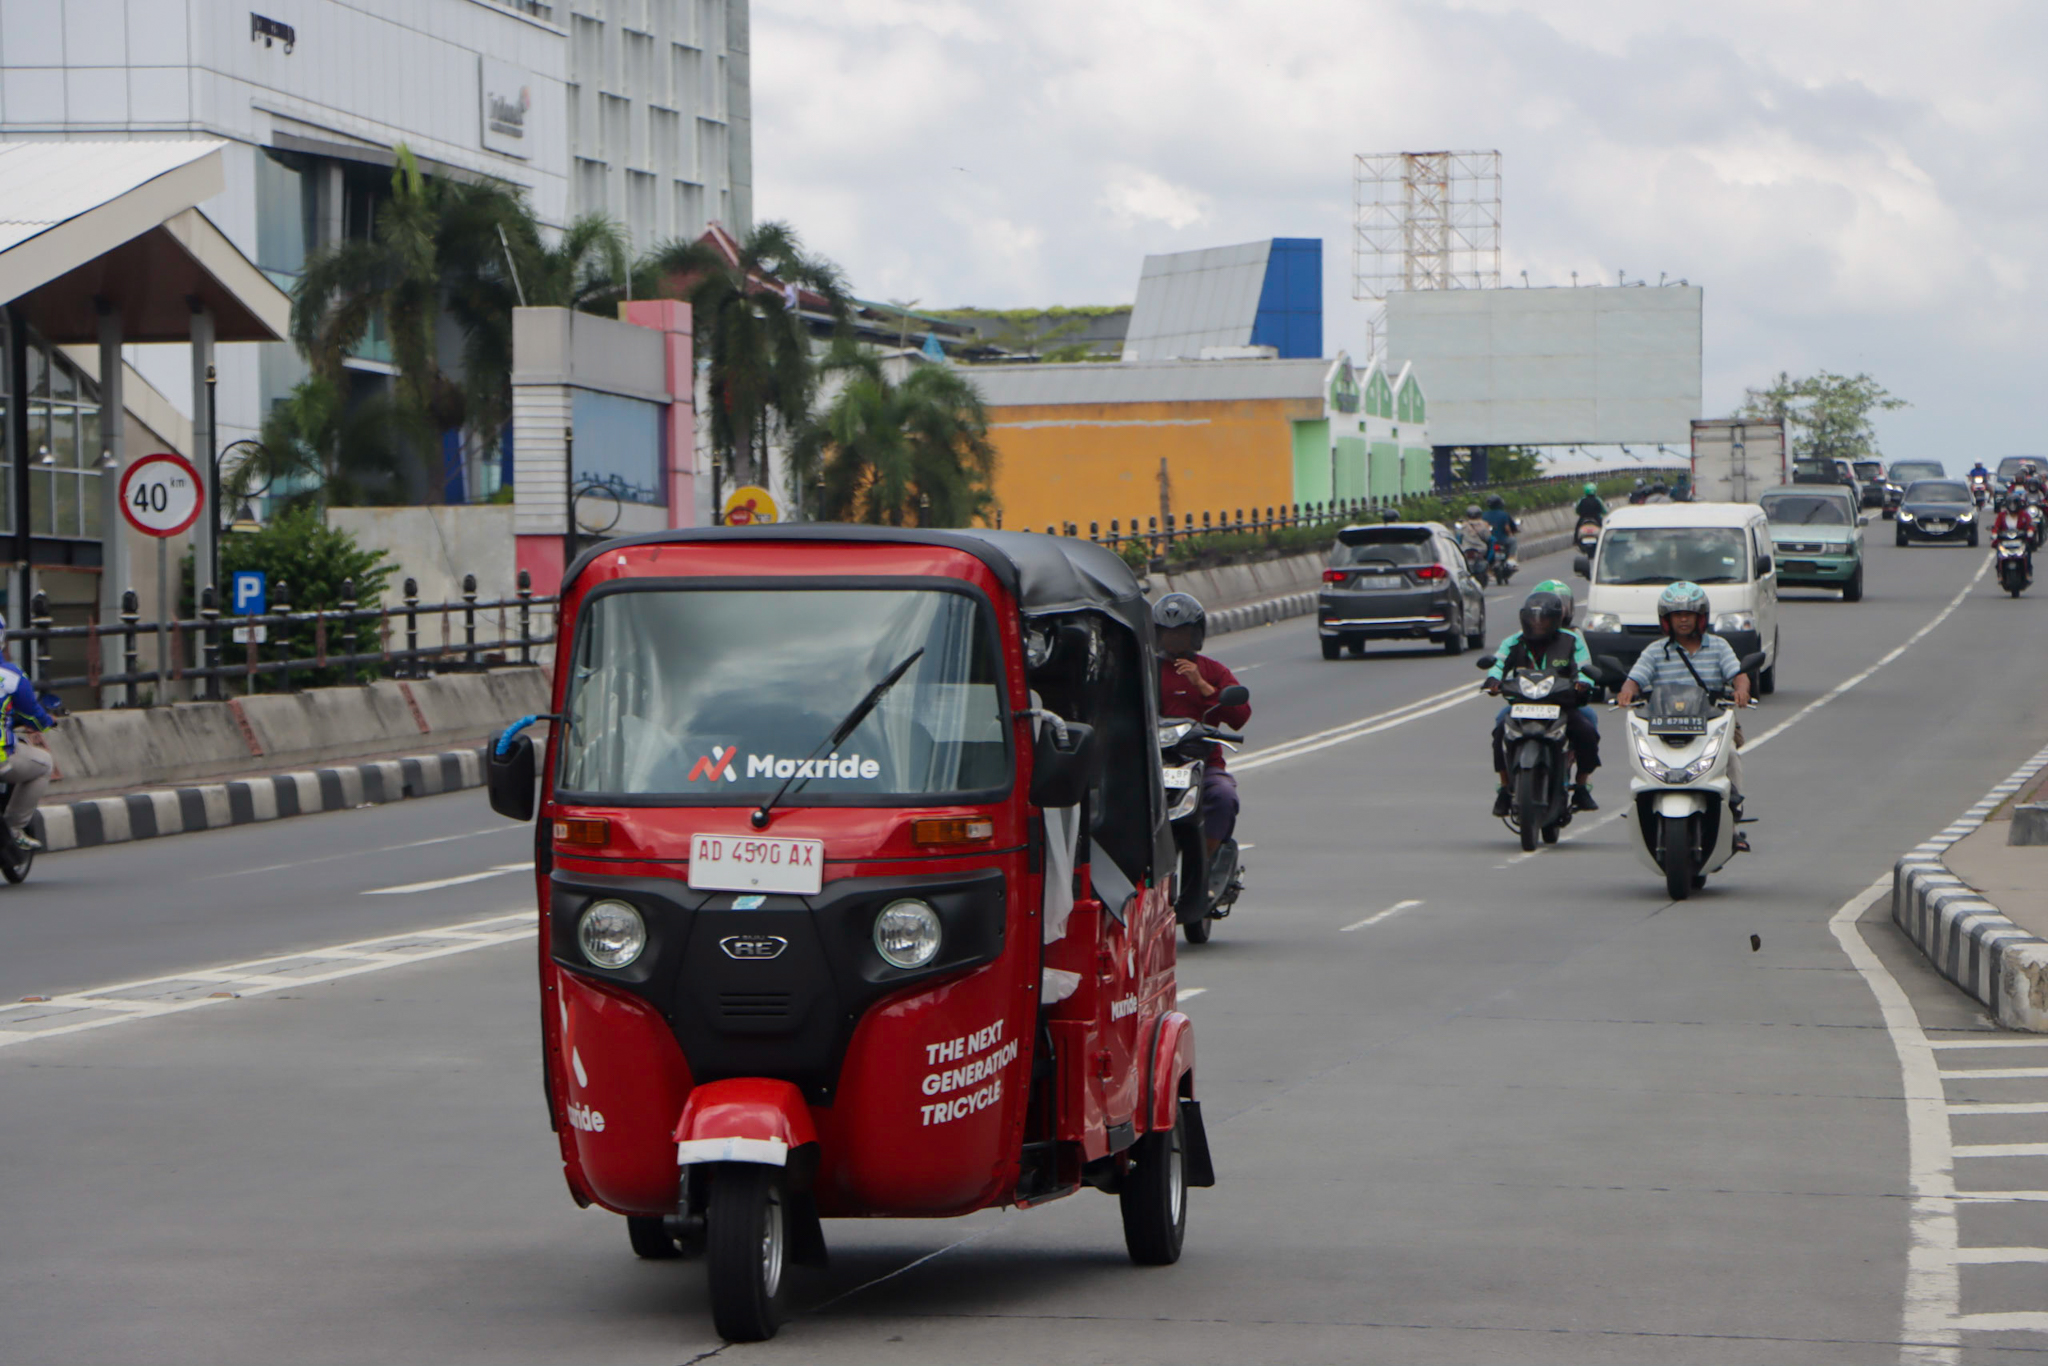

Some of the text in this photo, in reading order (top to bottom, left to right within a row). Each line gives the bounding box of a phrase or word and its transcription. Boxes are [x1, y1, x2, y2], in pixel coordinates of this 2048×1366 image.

[134, 482, 167, 513] 40
[170, 477, 184, 488] km
[237, 576, 261, 609] P
[747, 752, 880, 779] Maxride
[699, 839, 814, 866] AD 4590 AX
[735, 942, 773, 955] RE
[926, 1019, 1004, 1066] THE NEXT
[922, 1038, 1018, 1096] GENERATION
[921, 1080, 1002, 1126] TRICYCLE
